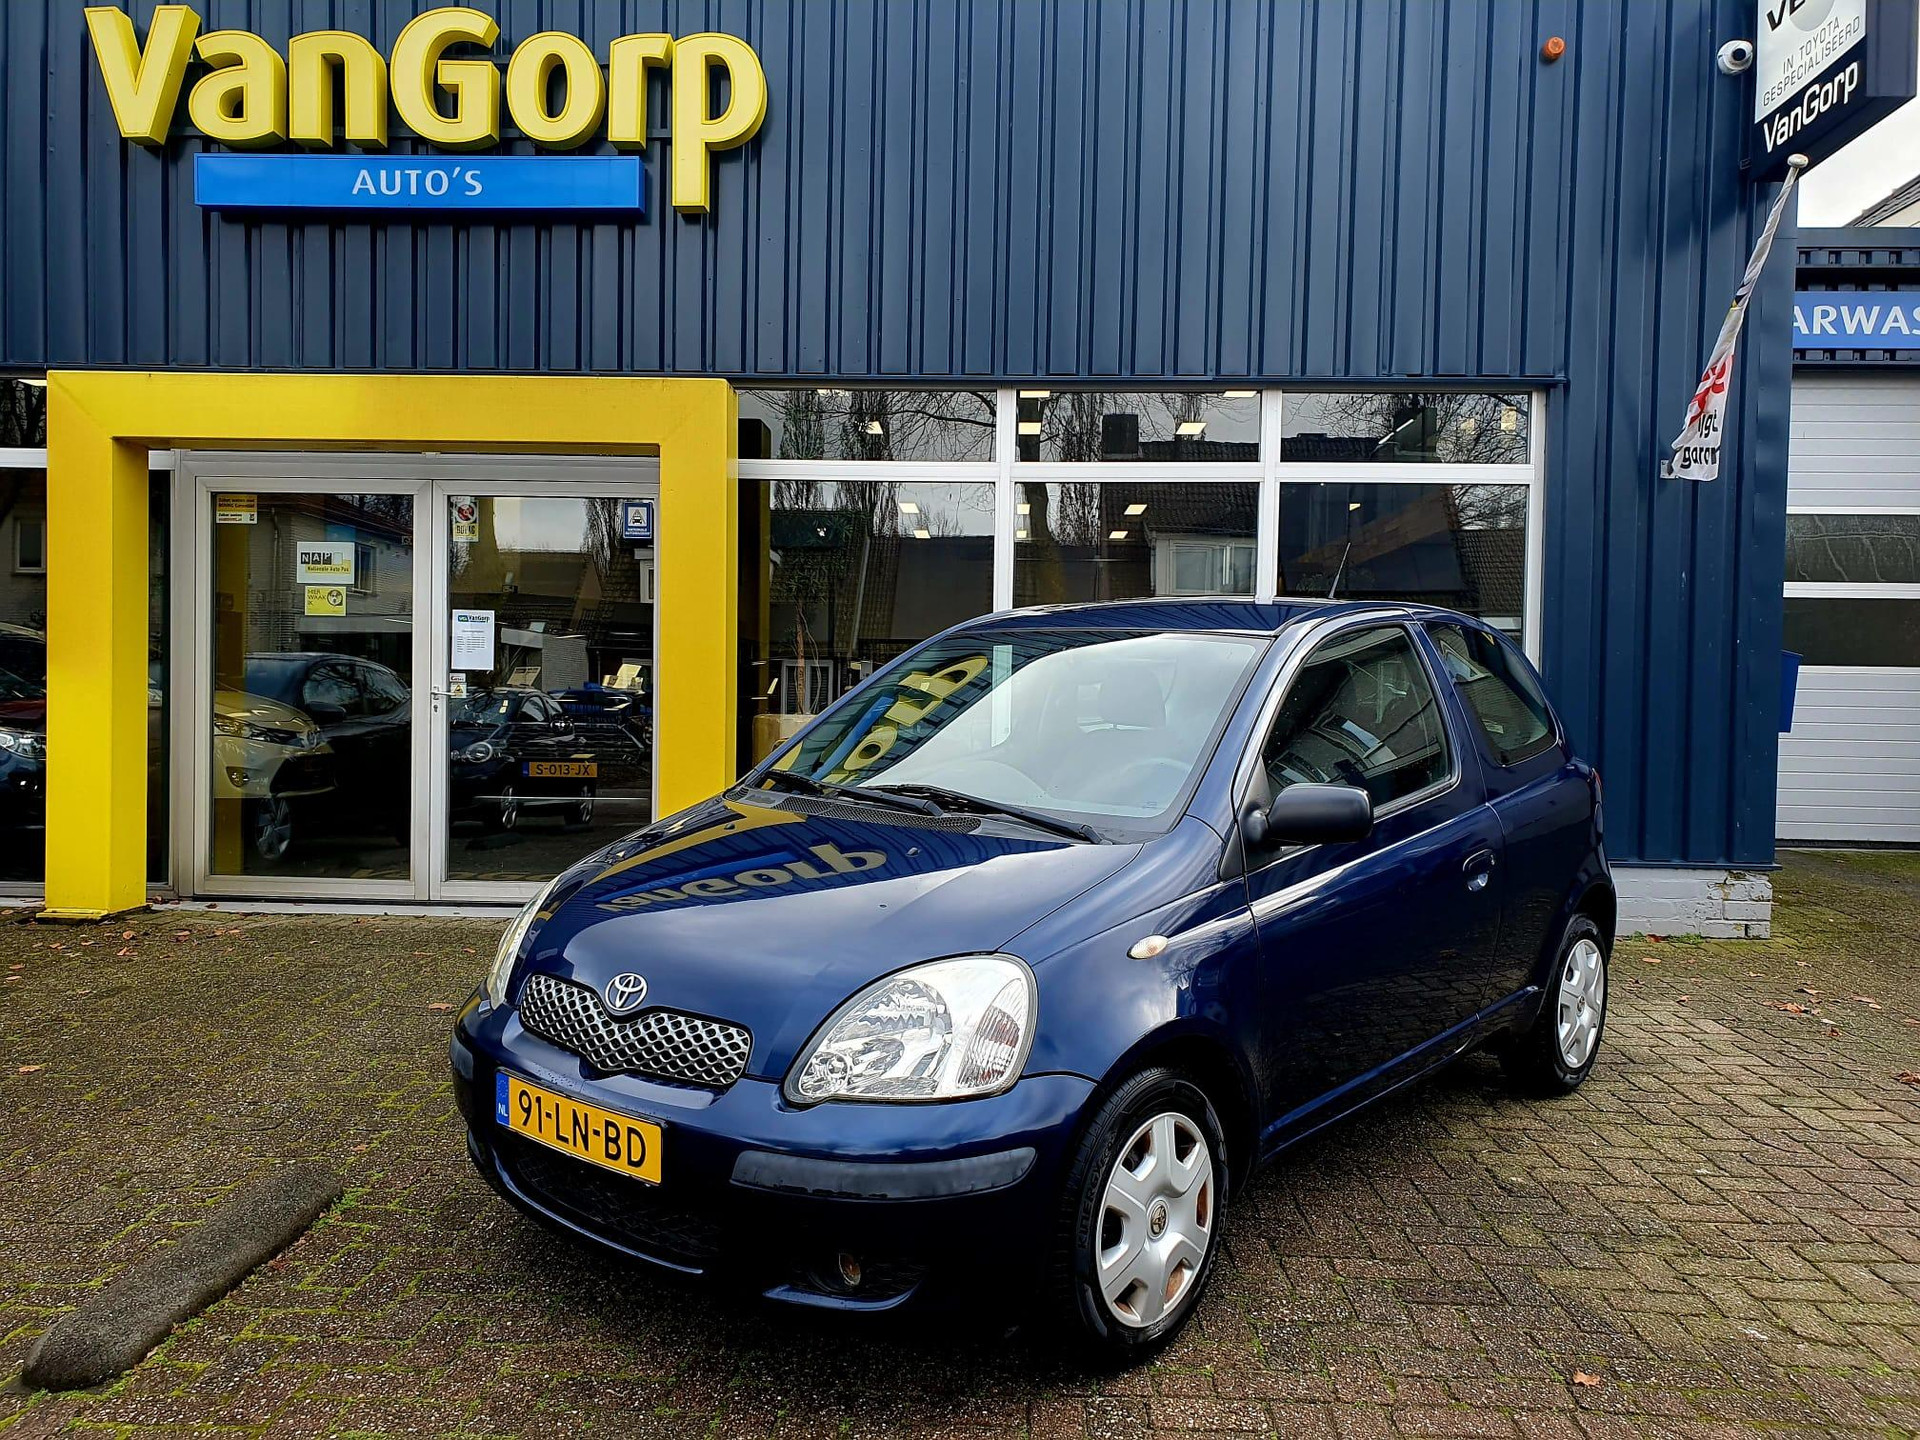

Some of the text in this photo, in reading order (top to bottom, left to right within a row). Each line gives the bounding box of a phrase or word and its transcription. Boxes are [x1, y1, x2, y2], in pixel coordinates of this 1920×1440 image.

[1763, 16, 1860, 106] GESPECIALISEERD
[1783, 16, 1840, 74] IN TOYOTA
[85, 4, 768, 214] VanGorp
[1763, 61, 1860, 153] VanGorp
[351, 166, 483, 196] AUTO'S
[302, 552, 331, 563] NAP
[535, 764, 591, 776] S-013-JX
[498, 1103, 508, 1117] NL
[518, 1089, 646, 1168] 91-LN-BD
